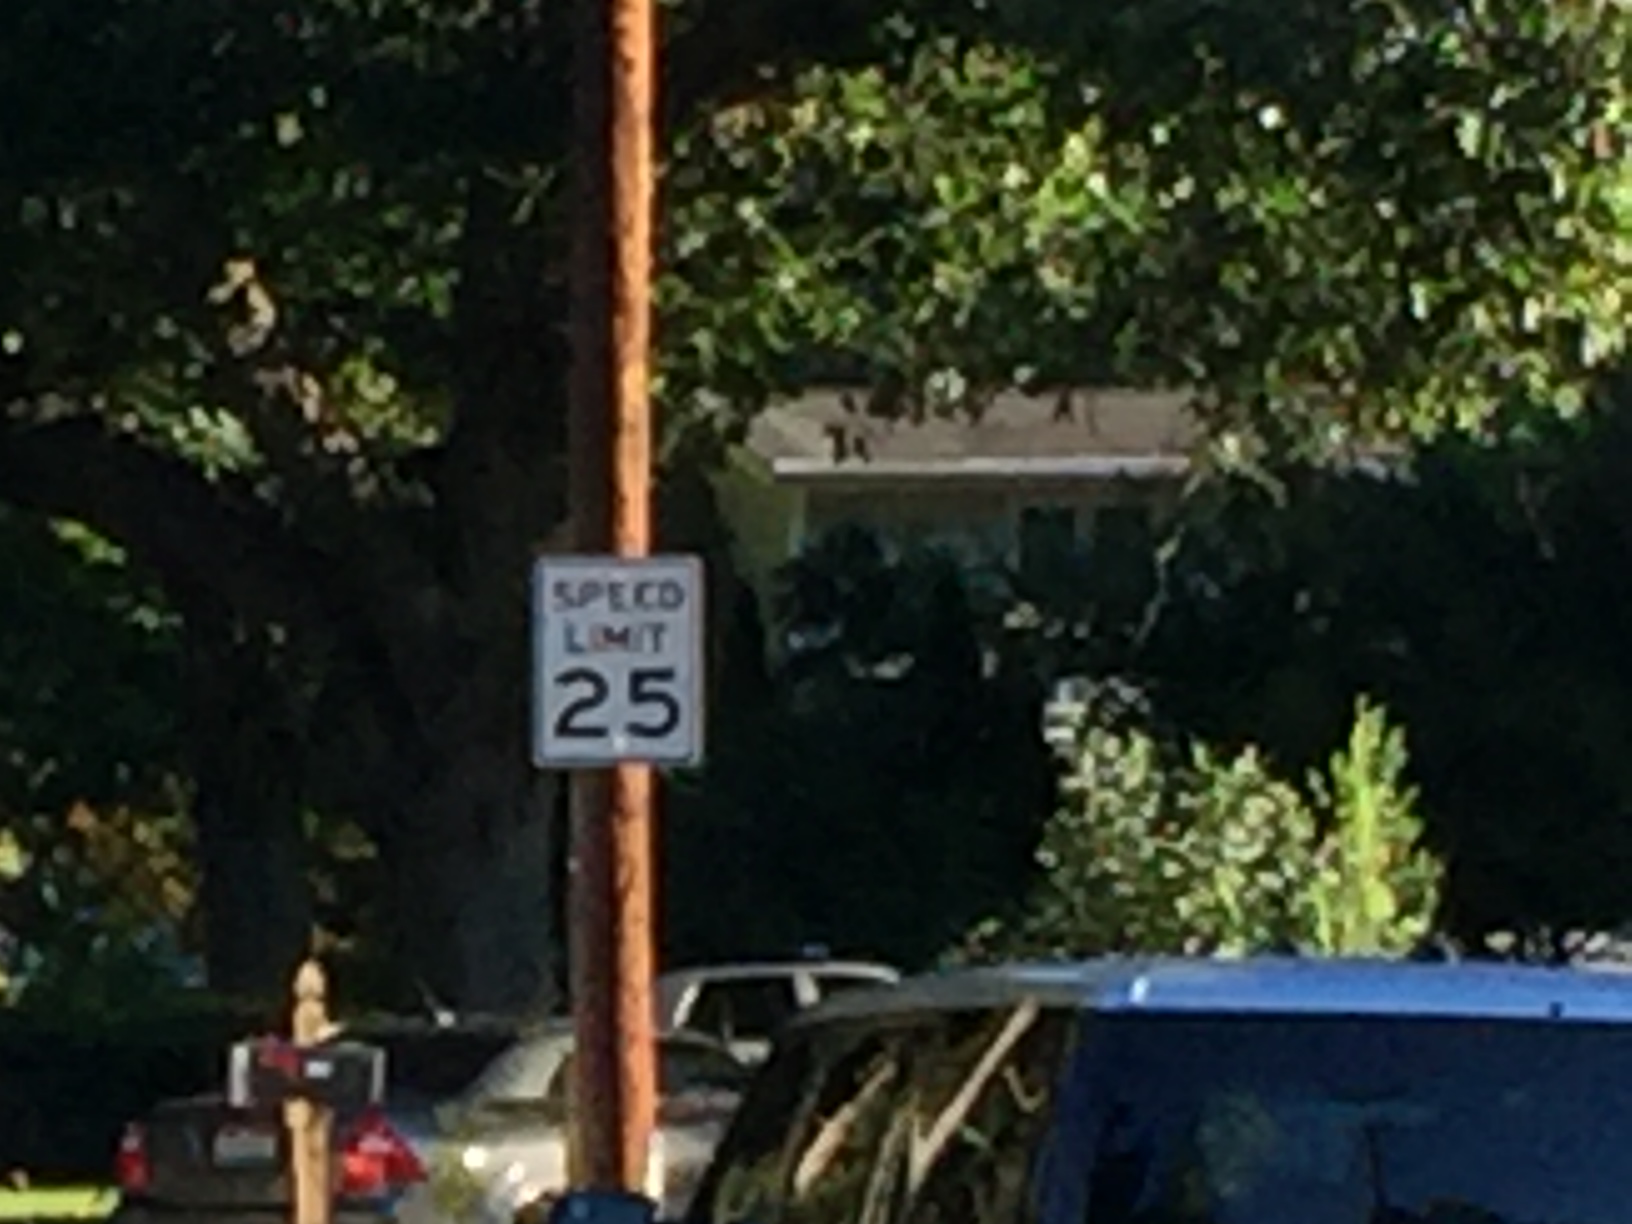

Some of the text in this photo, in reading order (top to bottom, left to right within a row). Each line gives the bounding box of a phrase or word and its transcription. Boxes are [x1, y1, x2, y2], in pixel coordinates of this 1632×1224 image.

[552, 579, 686, 613] SPEED
[563, 621, 667, 654] LIMIT
[553, 667, 681, 739] 25
